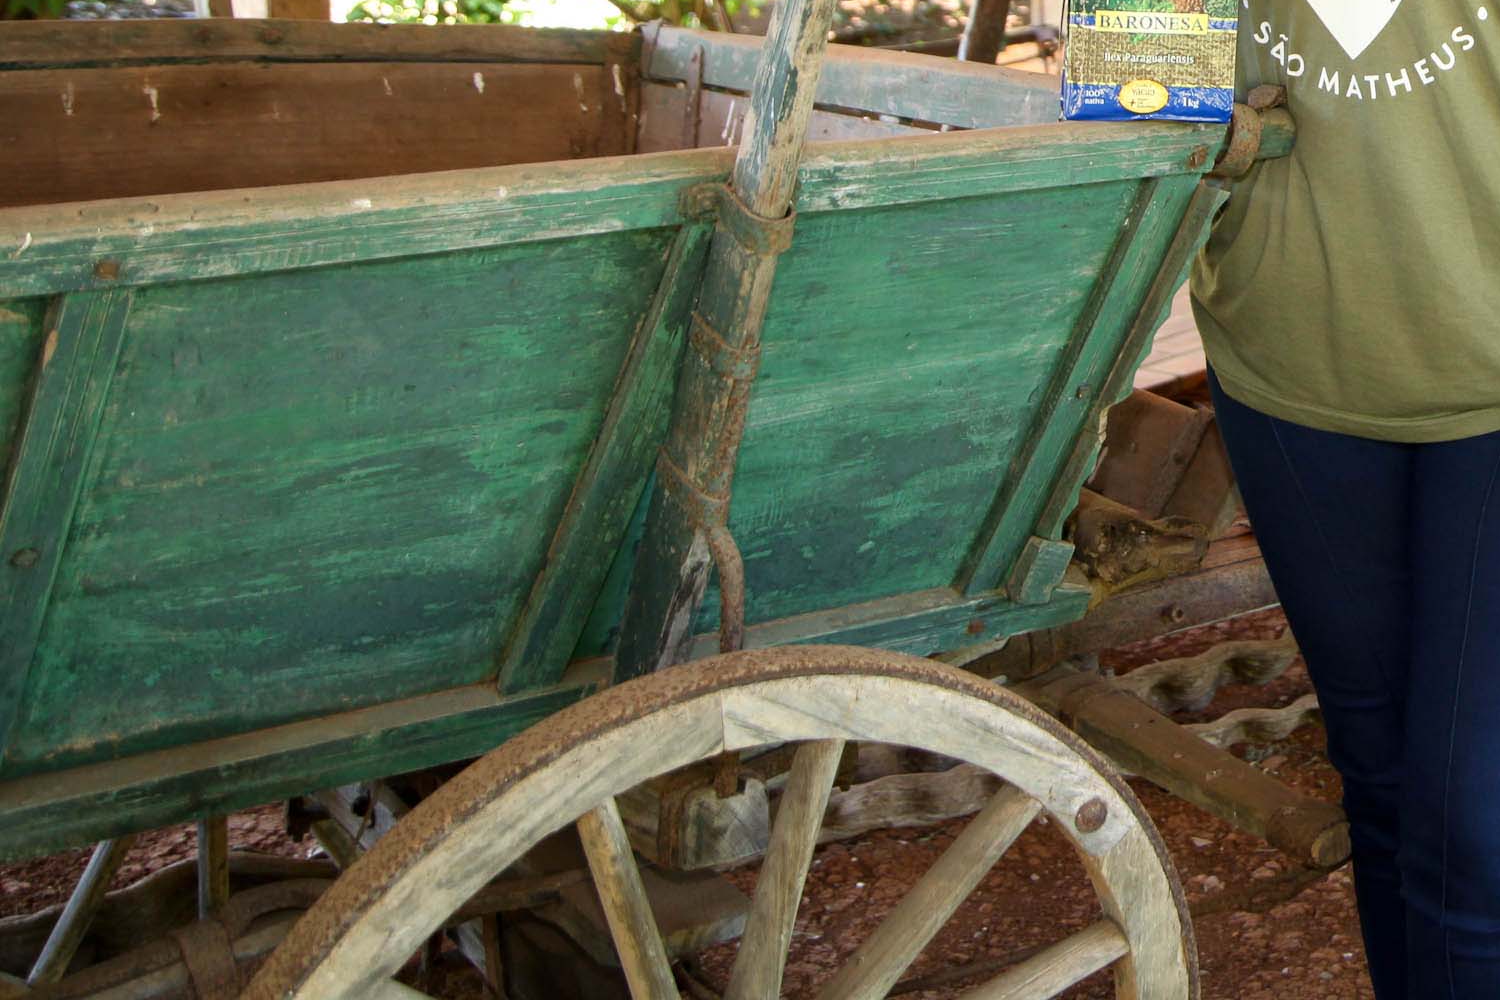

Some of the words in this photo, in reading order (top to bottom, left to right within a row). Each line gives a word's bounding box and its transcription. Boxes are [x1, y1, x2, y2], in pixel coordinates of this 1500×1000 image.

[1100, 14, 1204, 32] BARONESA
[1104, 51, 1122, 62] Ilex
[1253, 21, 1305, 77] SÃO
[1318, 26, 1475, 99] MATHEUS
